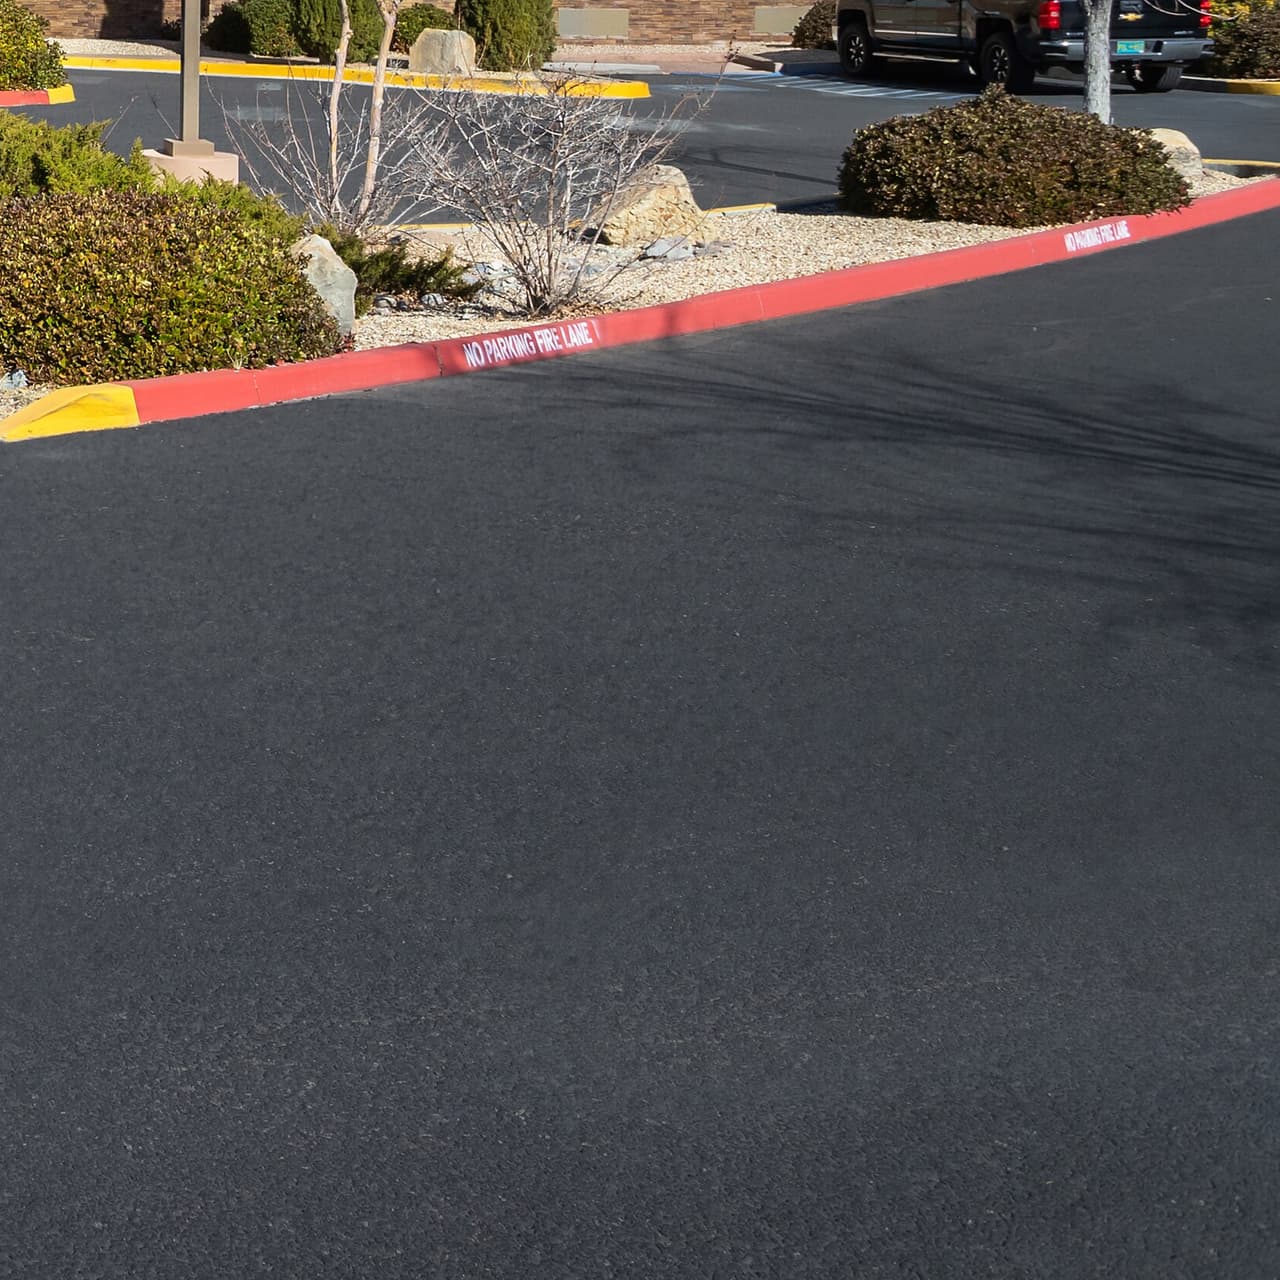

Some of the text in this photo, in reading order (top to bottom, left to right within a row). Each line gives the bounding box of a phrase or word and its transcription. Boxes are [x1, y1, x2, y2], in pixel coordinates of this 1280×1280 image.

[463, 322, 593, 367] NO PARKING FIRE LANE
